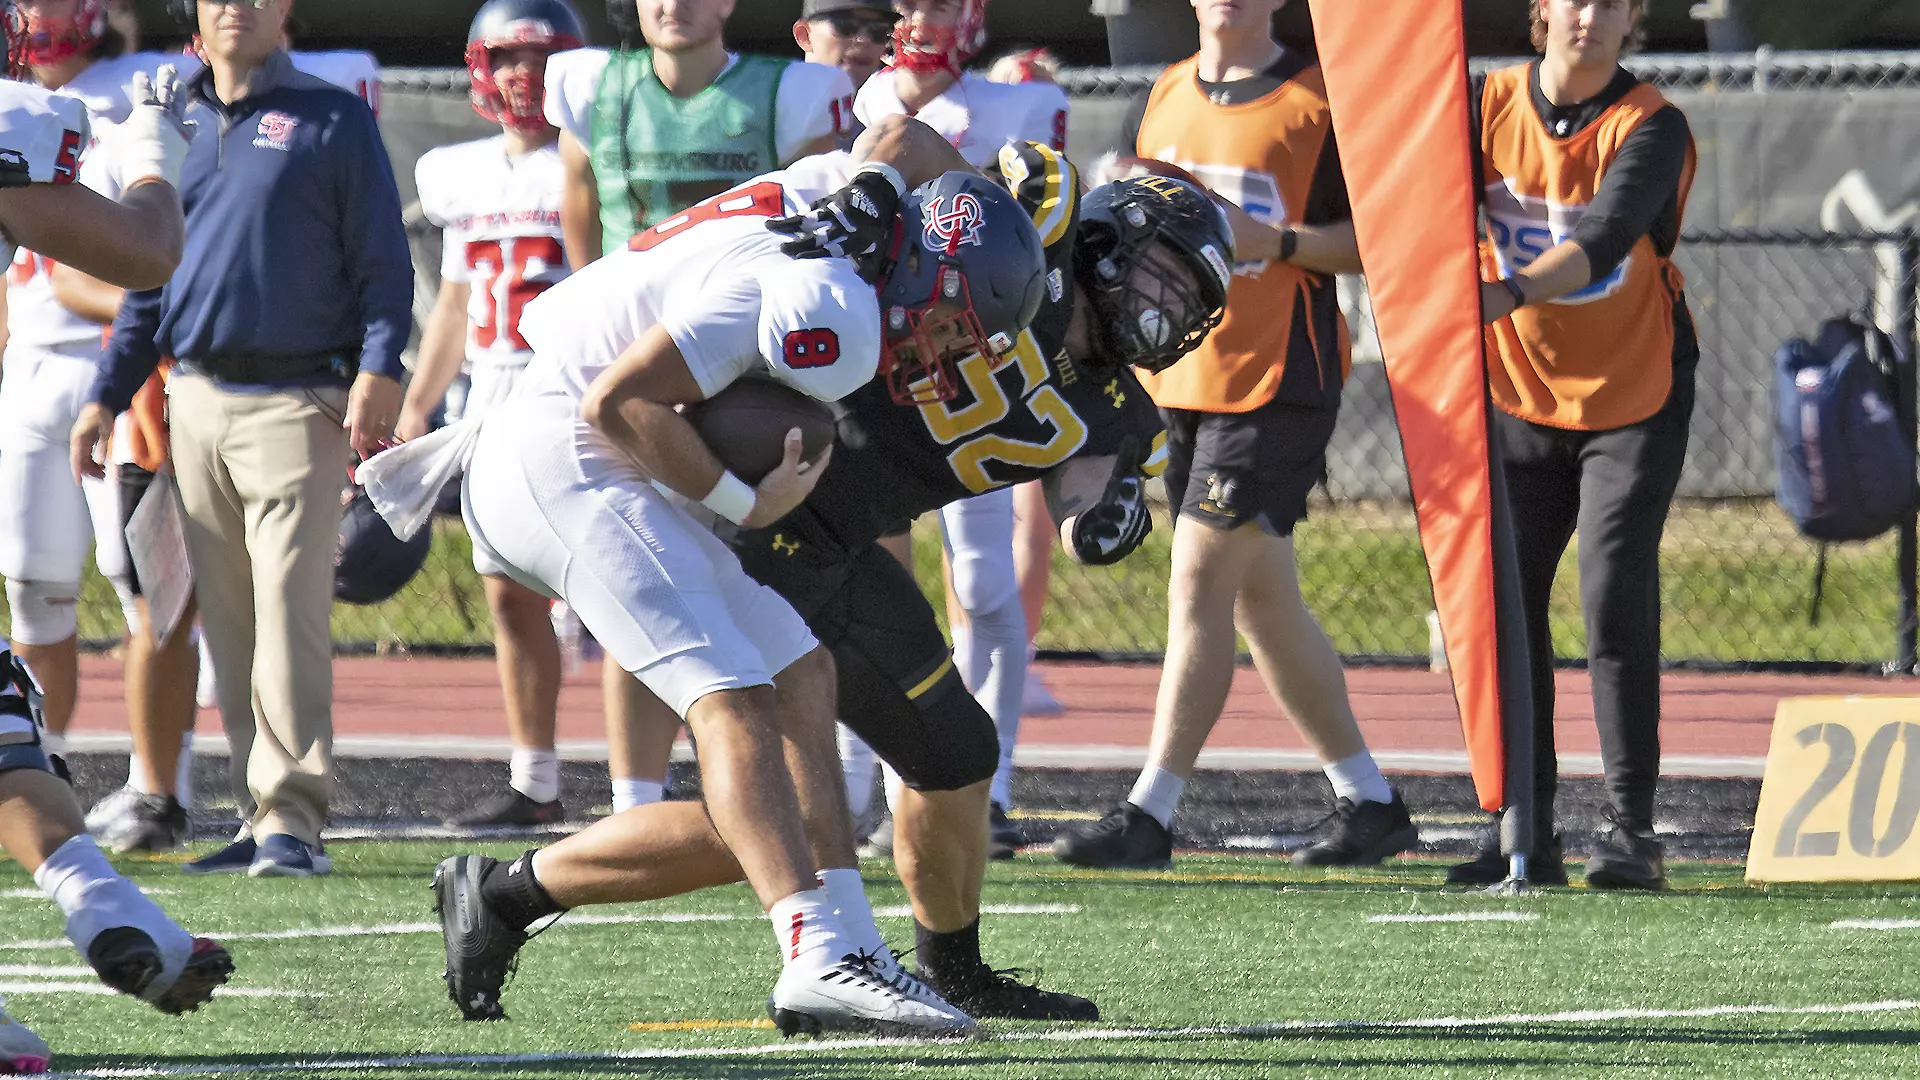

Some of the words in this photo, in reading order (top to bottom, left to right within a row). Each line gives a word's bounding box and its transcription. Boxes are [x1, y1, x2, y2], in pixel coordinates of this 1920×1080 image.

[782, 327, 841, 370] 8
[907, 326, 1089, 495] 52
[1772, 721, 1920, 859] 20
